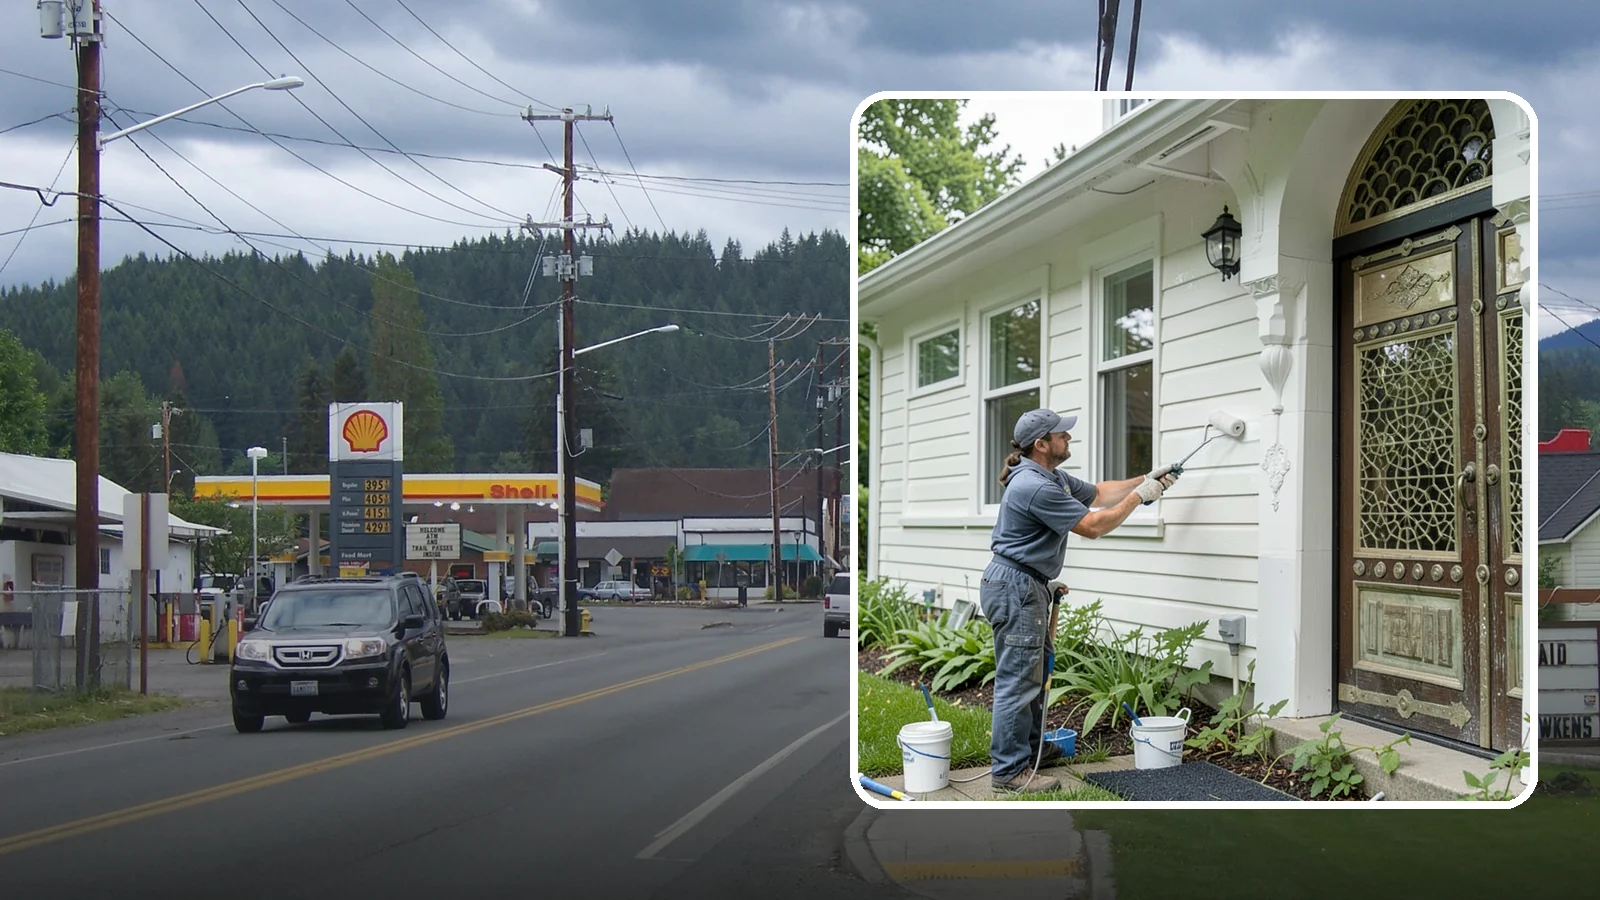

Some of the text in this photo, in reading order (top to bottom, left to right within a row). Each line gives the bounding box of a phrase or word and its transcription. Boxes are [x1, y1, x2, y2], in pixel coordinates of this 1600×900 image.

[366, 480, 383, 490] 395
[490, 484, 547, 499] Shell
[366, 494, 383, 504] 405
[366, 508, 383, 518] 415
[366, 522, 383, 532] 429
